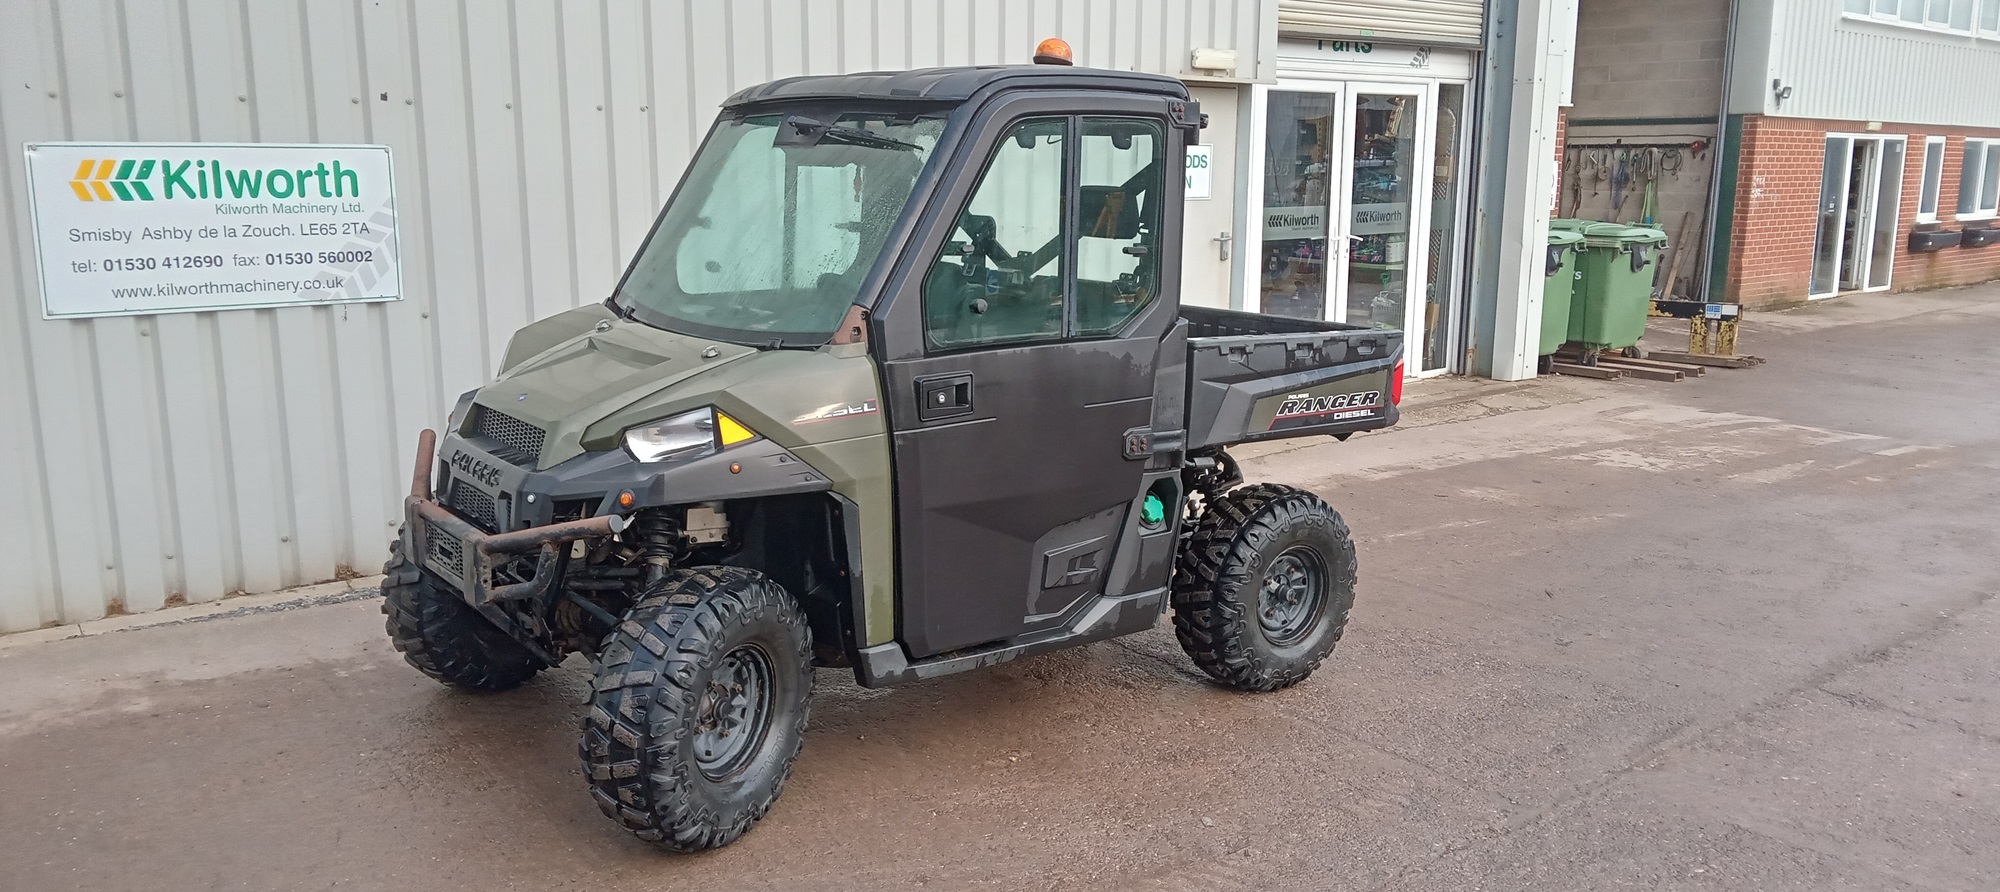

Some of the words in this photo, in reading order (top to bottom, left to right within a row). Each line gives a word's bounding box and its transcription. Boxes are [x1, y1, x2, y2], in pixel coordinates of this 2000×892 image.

[1185, 154, 1208, 169] ODS
[161, 159, 359, 200] Kilworth
[215, 203, 268, 215] Kilworth
[272, 202, 338, 216] Machinery
[341, 202, 365, 213] Ltd.
[1283, 213, 1319, 227] Kilworth
[1369, 210, 1402, 223] Kilworth
[69, 228, 132, 244] Smisby
[141, 226, 193, 242] Ashby
[198, 225, 219, 239] de
[223, 225, 237, 238] la
[242, 224, 295, 238] Zouch.
[300, 223, 338, 236] LE65
[342, 222, 370, 235] 2TA
[71, 259, 97, 273] tel:
[103, 257, 156, 272] 01530
[162, 255, 223, 269] 412690
[233, 253, 260, 267] fax:
[265, 252, 314, 265] 01530
[318, 250, 373, 264] 560002
[111, 276, 344, 299] www.kilworthmachinery.co.uk
[1276, 391, 1379, 416] RANGER
[1333, 409, 1375, 420] DIESEL
[451, 449, 503, 488] POLARIS
